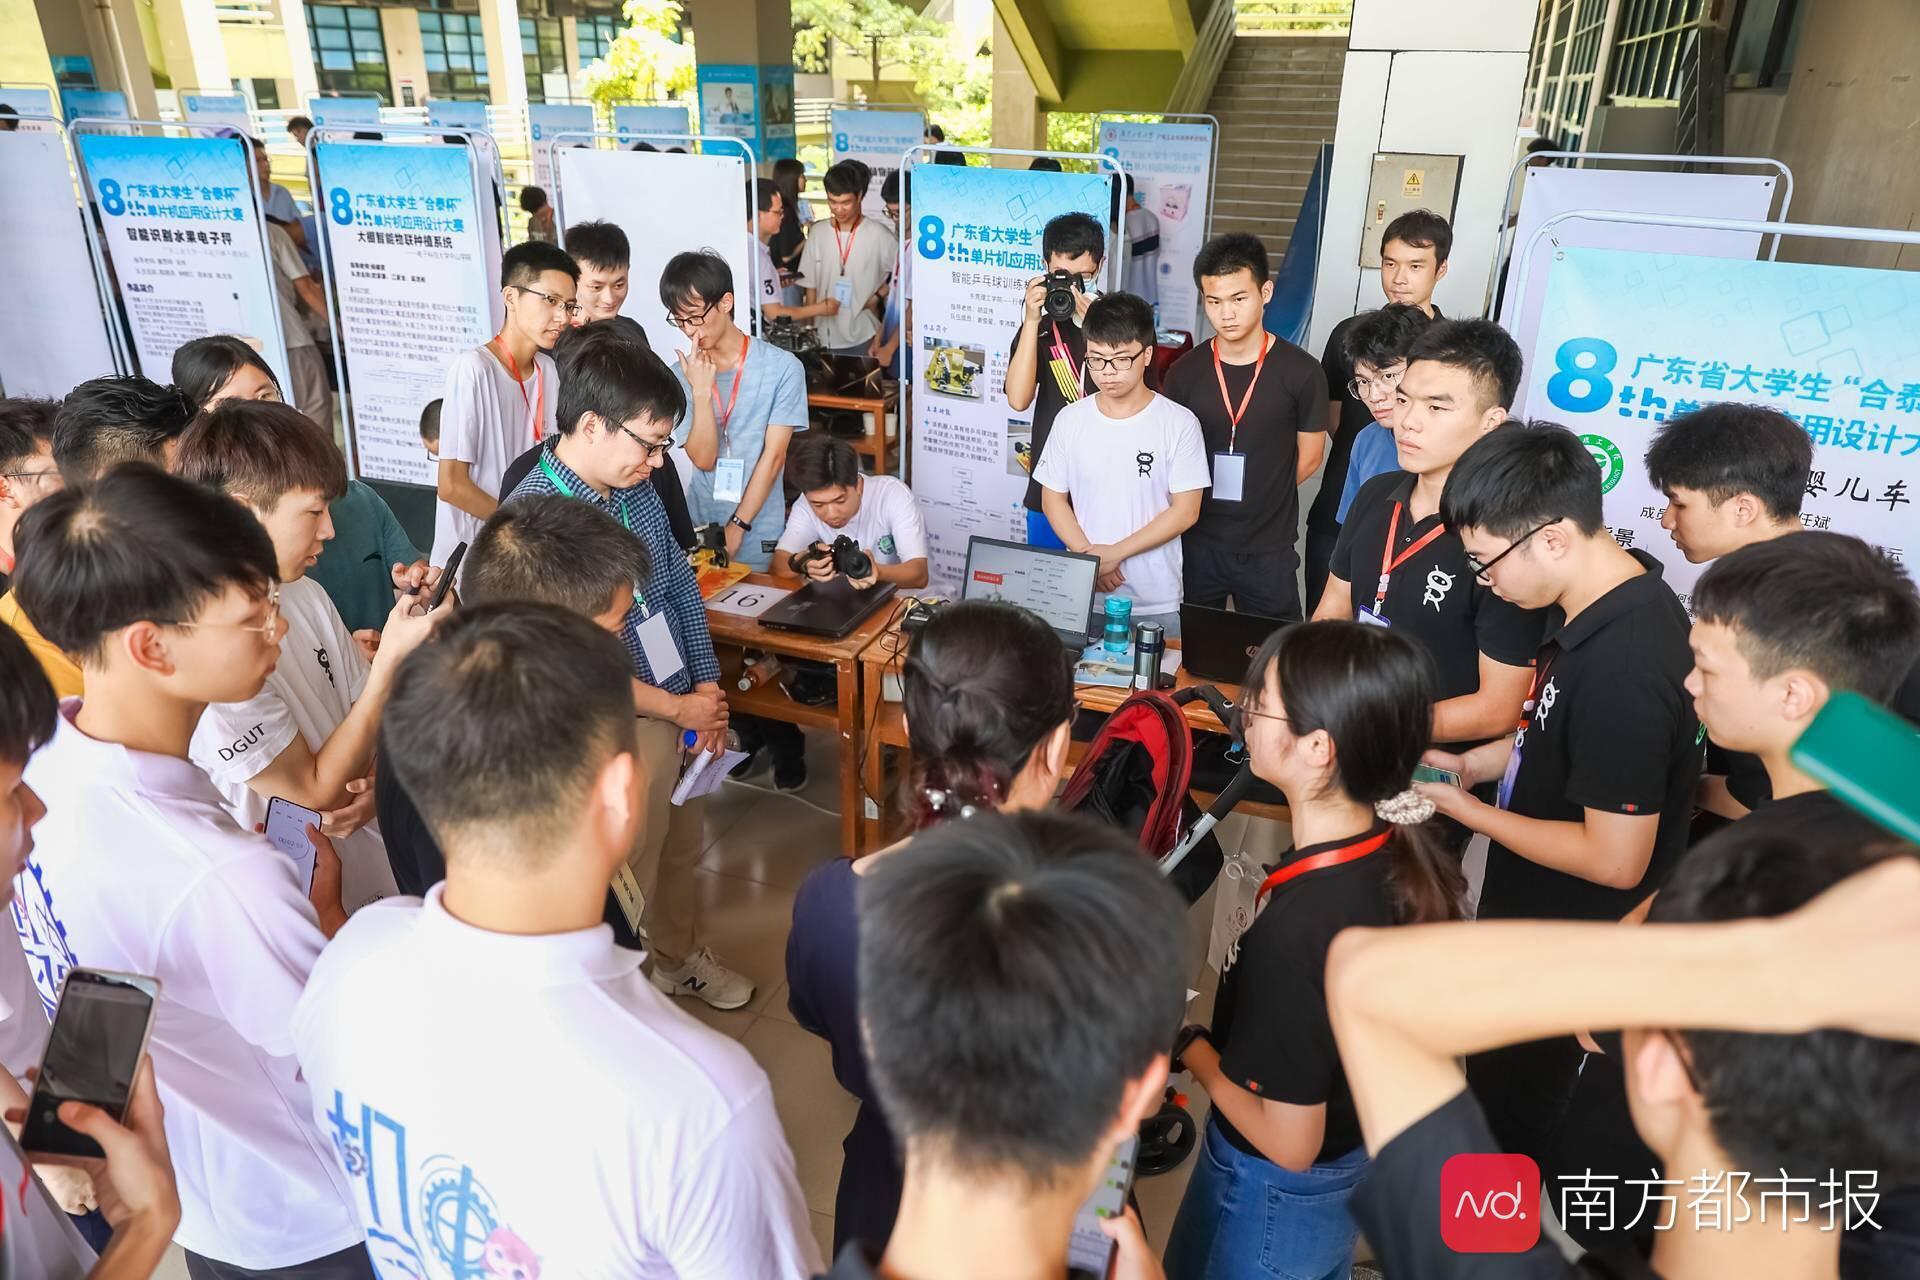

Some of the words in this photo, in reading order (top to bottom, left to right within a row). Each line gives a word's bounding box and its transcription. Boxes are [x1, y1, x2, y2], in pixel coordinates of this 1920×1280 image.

[835, 133, 849, 152] 8
[98, 178, 126, 217] 8
[330, 187, 353, 226] 8
[148, 204, 245, 222] 单片机应用设计大赛
[374, 214, 465, 233] 单片机应用设计大赛
[126, 227, 233, 246] 智能识别水果电子秤
[357, 231, 454, 249] 大棚智能物联种植系统
[917, 215, 946, 260] 8
[764, 279, 775, 295] 3
[1546, 336, 1618, 413] 8
[1618, 385, 1666, 423] th
[720, 590, 764, 608] 16
[218, 722, 264, 761] DGUT
